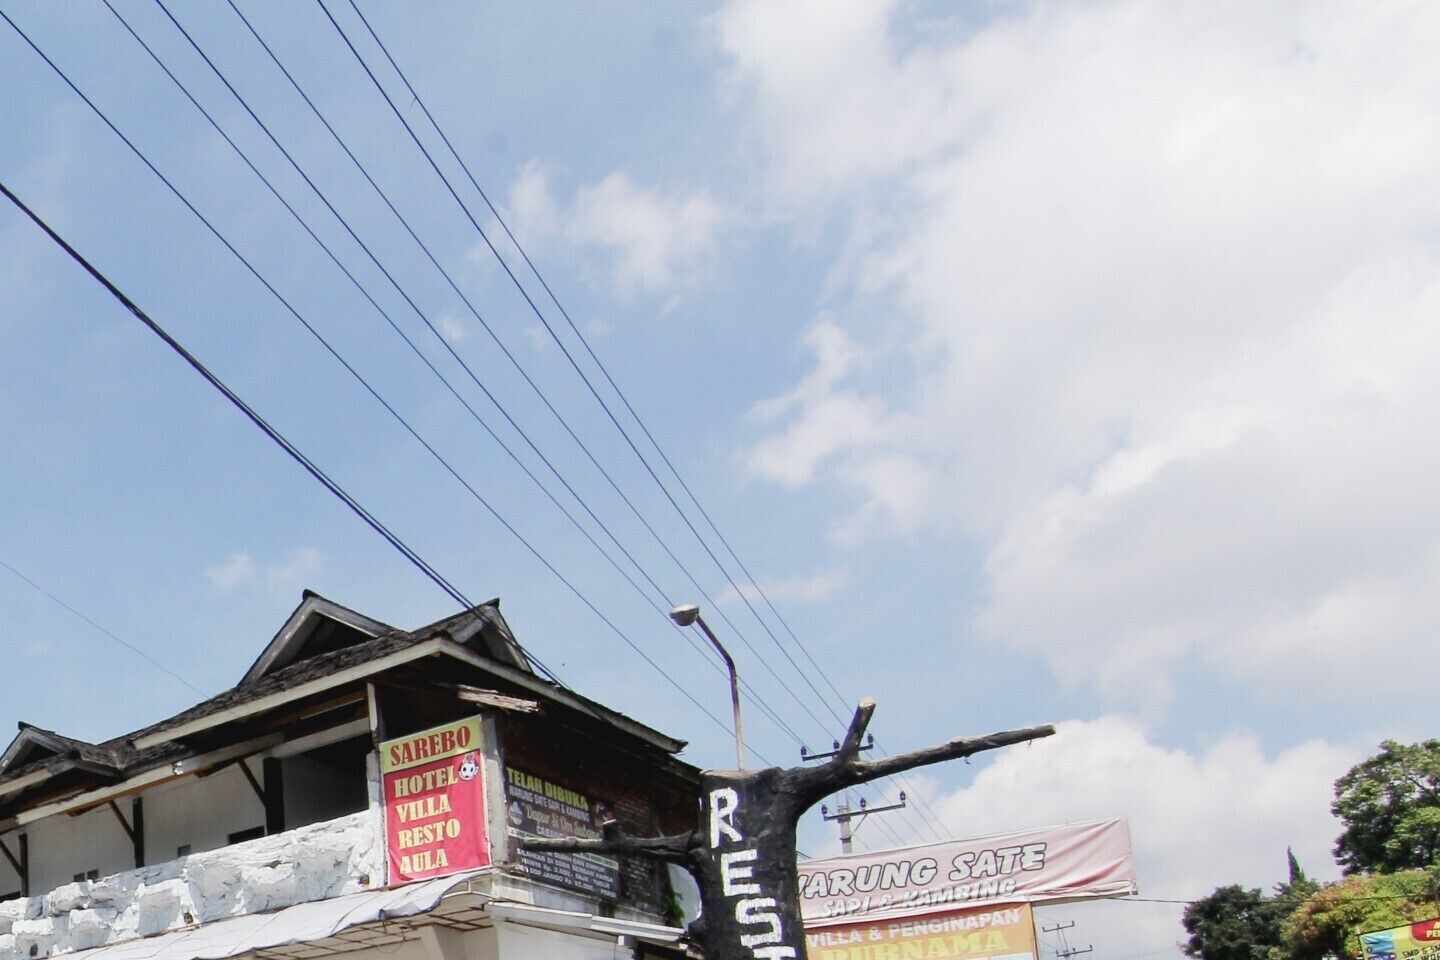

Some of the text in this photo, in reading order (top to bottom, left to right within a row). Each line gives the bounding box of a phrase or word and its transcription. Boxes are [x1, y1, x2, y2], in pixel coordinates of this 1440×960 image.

[390, 725, 471, 767] SAREBO
[394, 765, 459, 798] HOTEL
[506, 767, 543, 795] TELAH
[396, 794, 452, 824] VILLA
[398, 818, 461, 850] RESTO
[399, 848, 449, 875] AULA
[949, 842, 1047, 881] SATE
[821, 895, 872, 918] SAPI
[902, 878, 1017, 909] KAMBING
[809, 908, 1022, 949] VILLA & PENGINAPAN
